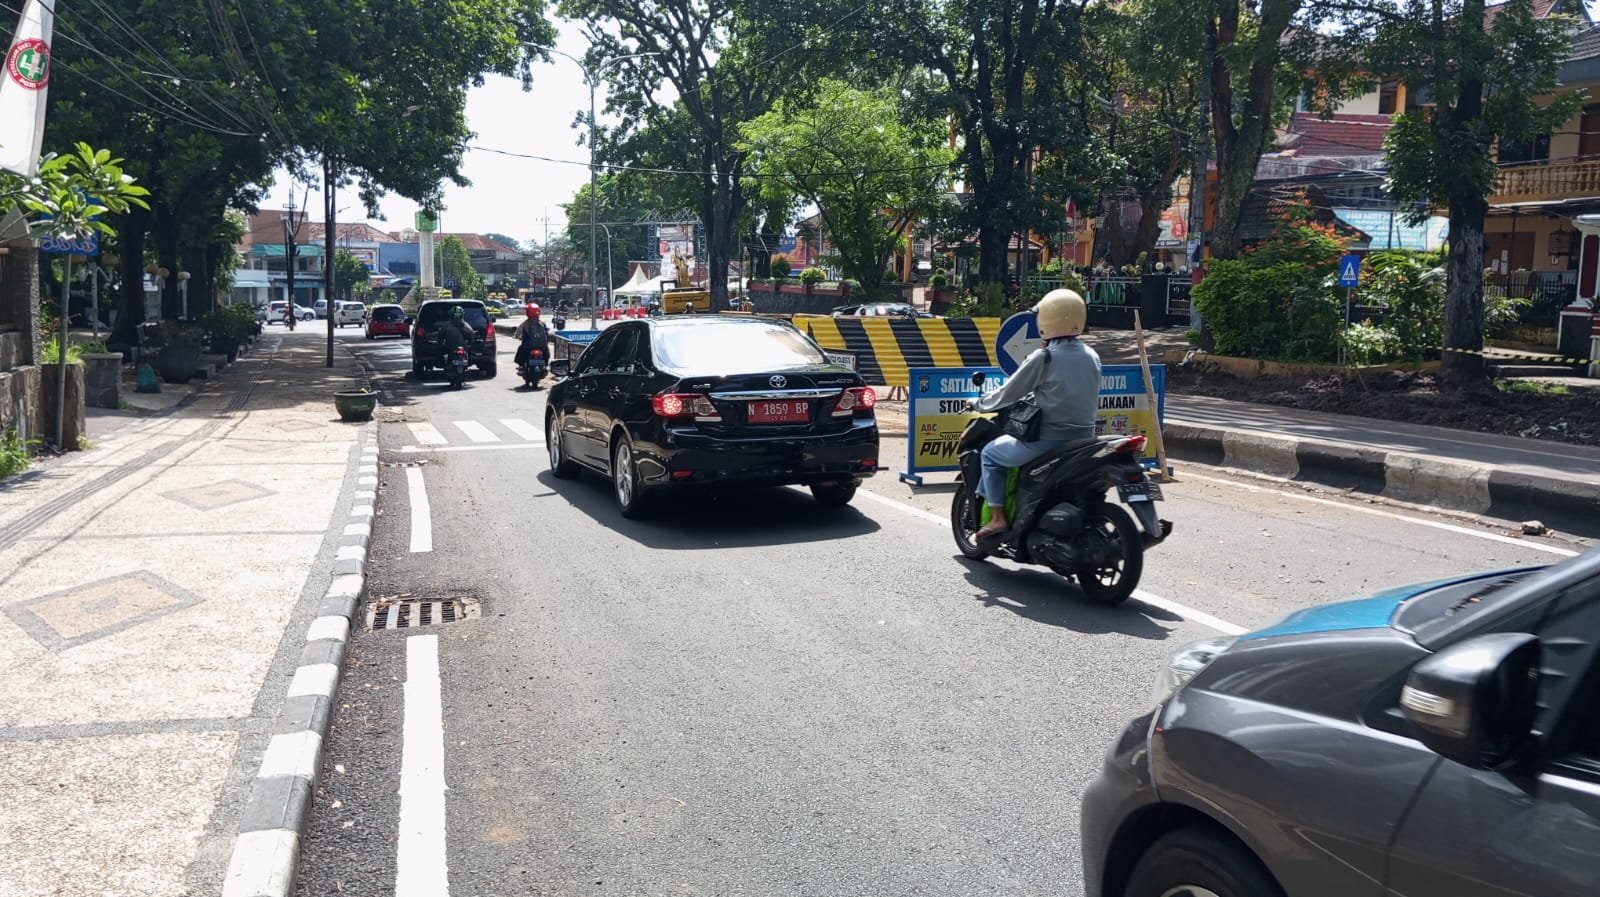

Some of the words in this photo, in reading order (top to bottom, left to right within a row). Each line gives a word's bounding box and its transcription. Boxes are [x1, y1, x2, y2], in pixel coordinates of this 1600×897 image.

[1090, 282, 1126, 304] LANG
[1100, 375, 1127, 390] KOTA
[748, 404, 755, 416] N
[763, 403, 789, 415] 1859
[795, 402, 809, 414] BP
[1098, 396, 1136, 409] LAKAAN
[920, 424, 937, 433] ABC
[1111, 419, 1128, 428] ABC
[920, 441, 961, 459] POW
